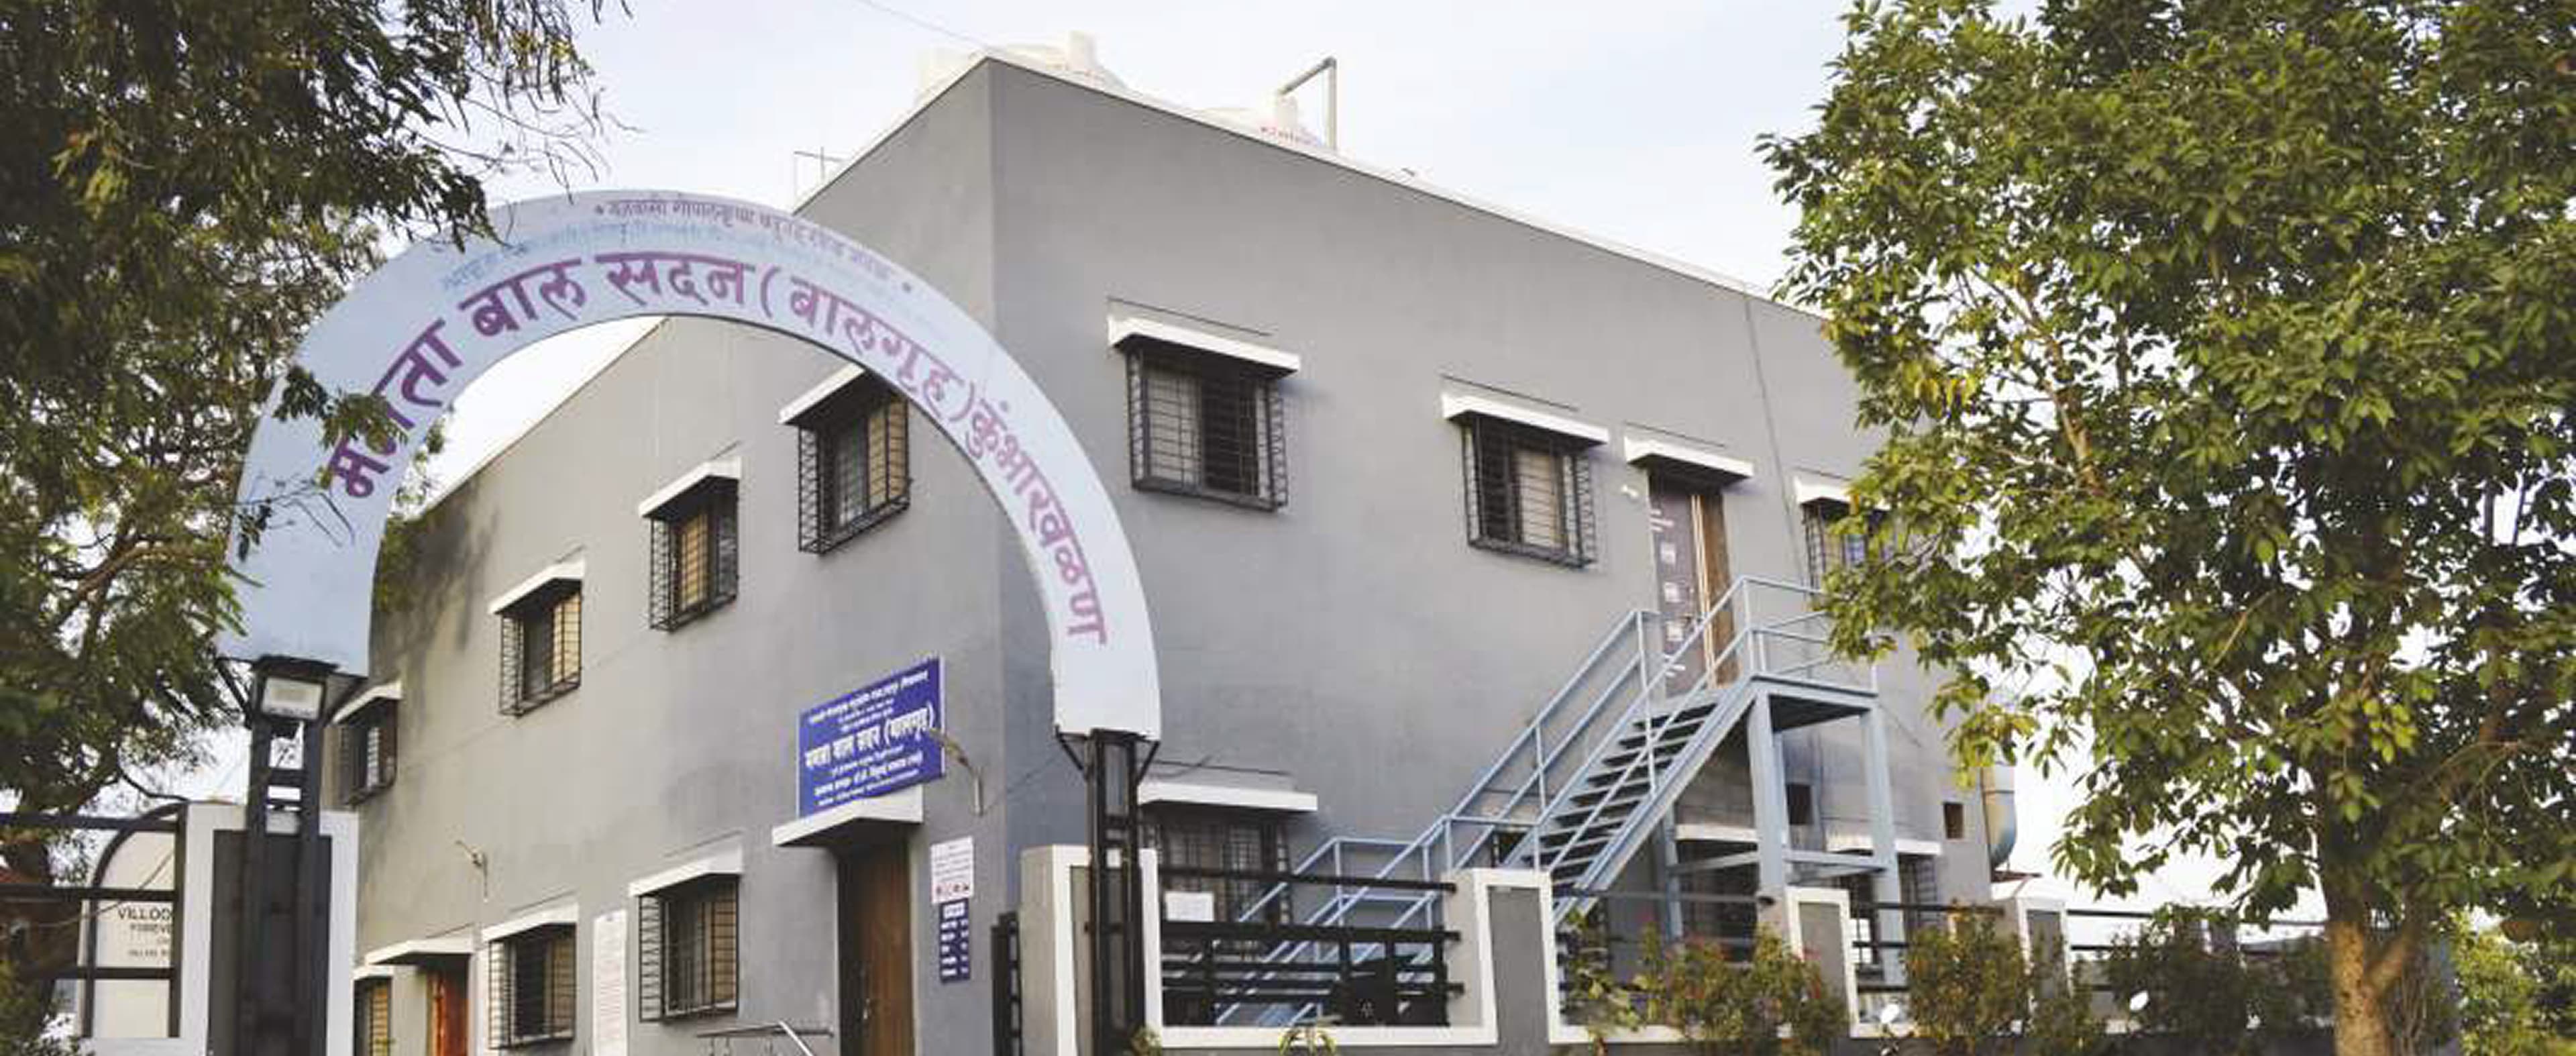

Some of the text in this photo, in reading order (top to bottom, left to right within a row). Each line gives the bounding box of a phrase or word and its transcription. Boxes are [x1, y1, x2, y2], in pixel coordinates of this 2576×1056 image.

[330, 318, 463, 499] मता
[459, 258, 587, 339] बाल
[594, 250, 757, 307] सदन
